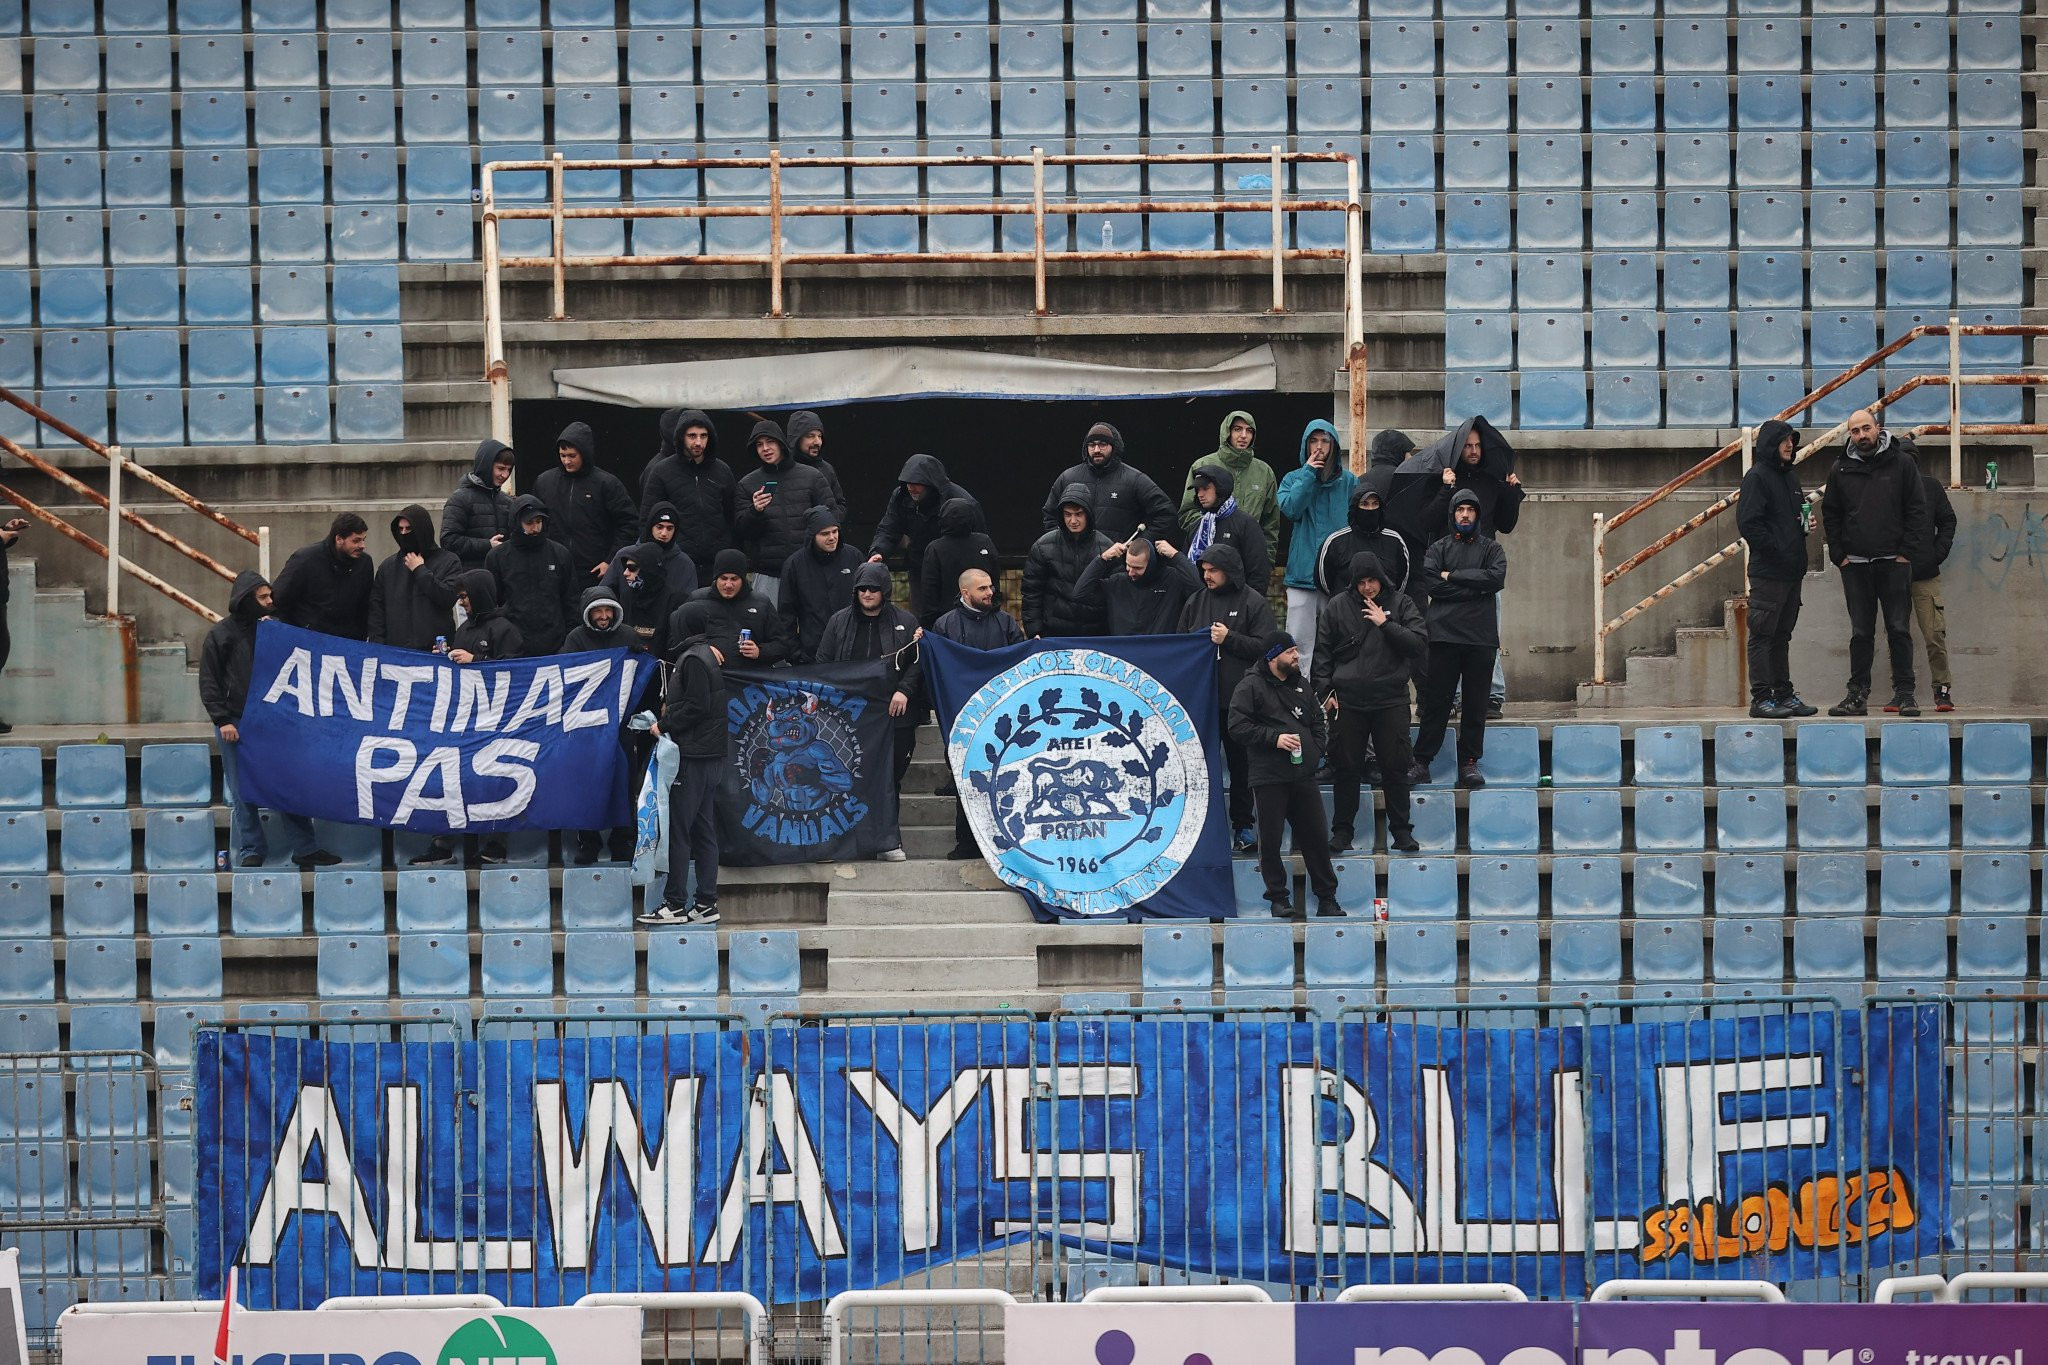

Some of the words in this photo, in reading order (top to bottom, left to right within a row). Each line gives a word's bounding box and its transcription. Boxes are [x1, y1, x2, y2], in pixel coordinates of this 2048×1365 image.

[263, 646, 639, 734] ANTINAZI
[951, 650, 1075, 748] ΣΥΝΔΕΣΜΟΣ
[1084, 650, 1196, 745] ΦΙΛΑΘΛΩΝ
[356, 735, 542, 829] PAS
[741, 795, 869, 846] VANDALS
[1056, 856, 1099, 874] 1966
[236, 1063, 1146, 1272] ALWAYS
